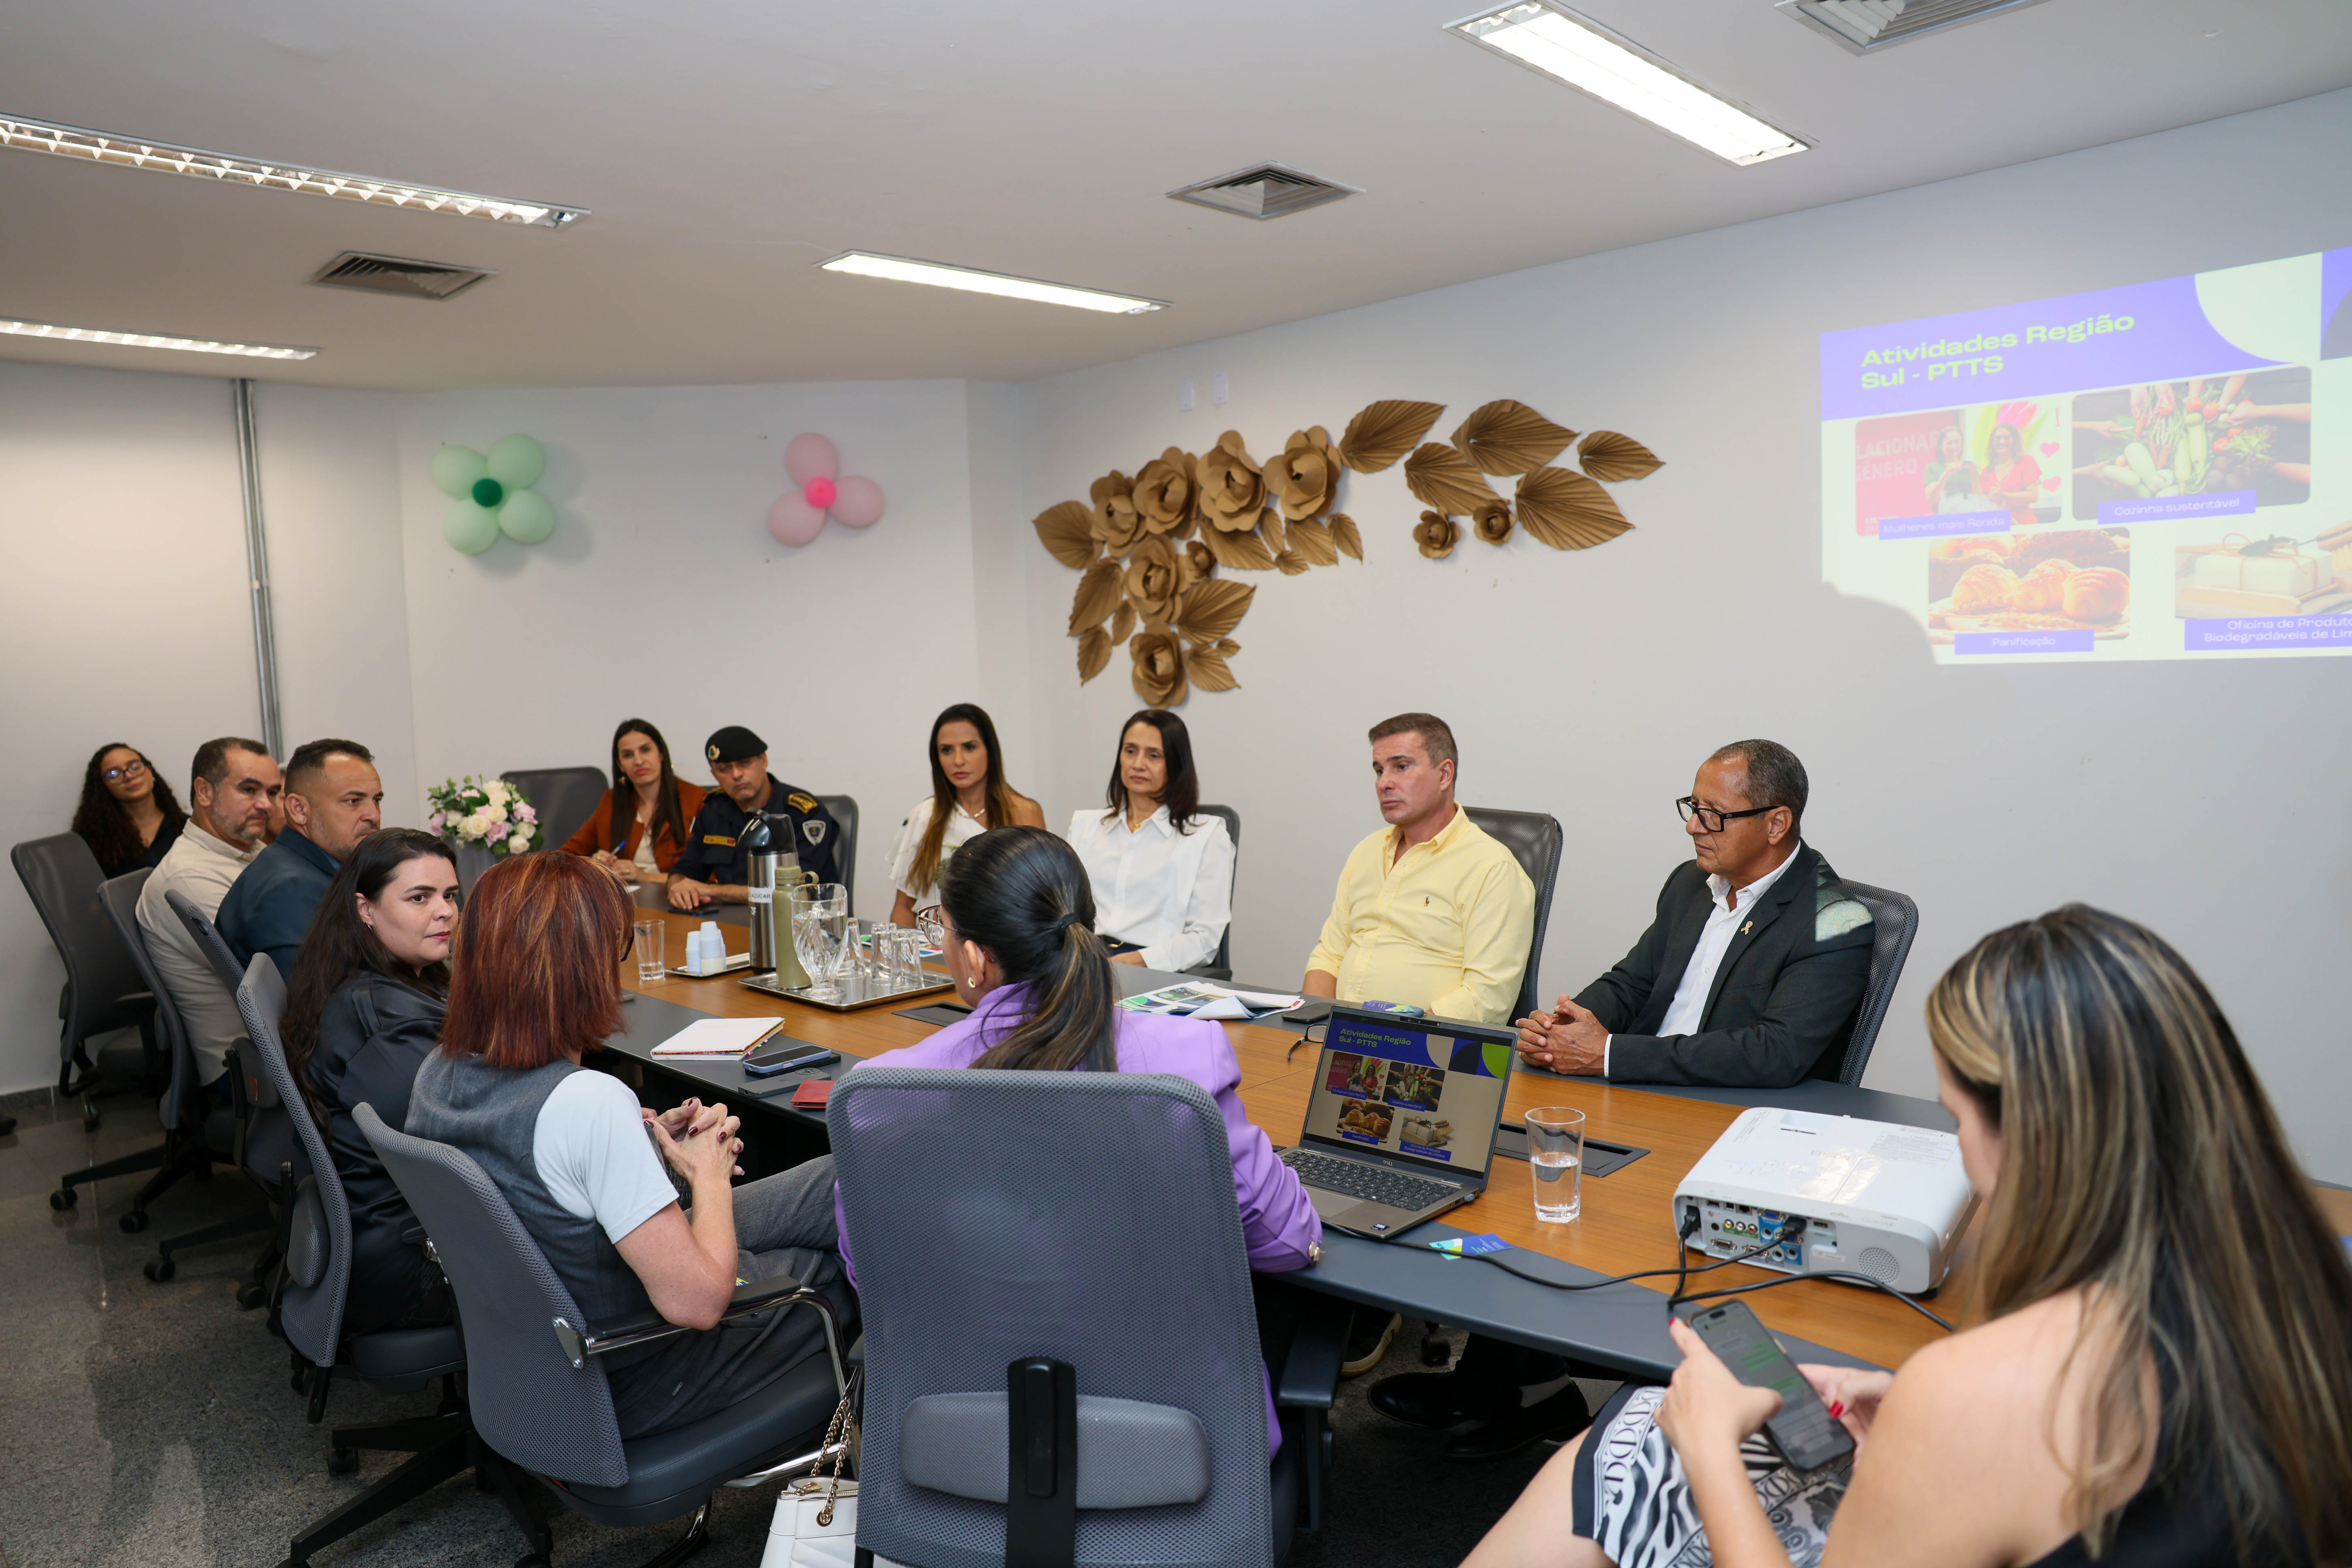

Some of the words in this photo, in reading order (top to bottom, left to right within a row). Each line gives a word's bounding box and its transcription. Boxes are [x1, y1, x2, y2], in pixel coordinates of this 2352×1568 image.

[1861, 333, 2018, 367] Atividades
[2026, 314, 2135, 343] Região
[1861, 368, 1904, 389] Sul
[1928, 356, 2004, 381] PTTS
[2114, 505, 2163, 516] Cozinha
[2166, 497, 2240, 512] sustentável
[1883, 522, 1936, 533] Mulheres
[1938, 520, 1965, 529] mais
[1967, 516, 2005, 527] Renda
[2228, 620, 2274, 630] Oficina
[2277, 618, 2294, 628] de
[1992, 636, 2056, 648] Panificação
[2204, 630, 2307, 643] Biodegradáveis
[2311, 629, 2329, 639] de
[1340, 1028, 1383, 1040] Atividades
[1384, 1035, 1411, 1046] Região
[1357, 1038, 1377, 1048] PTTS
[1810, 1150, 1851, 1161] EPSON
